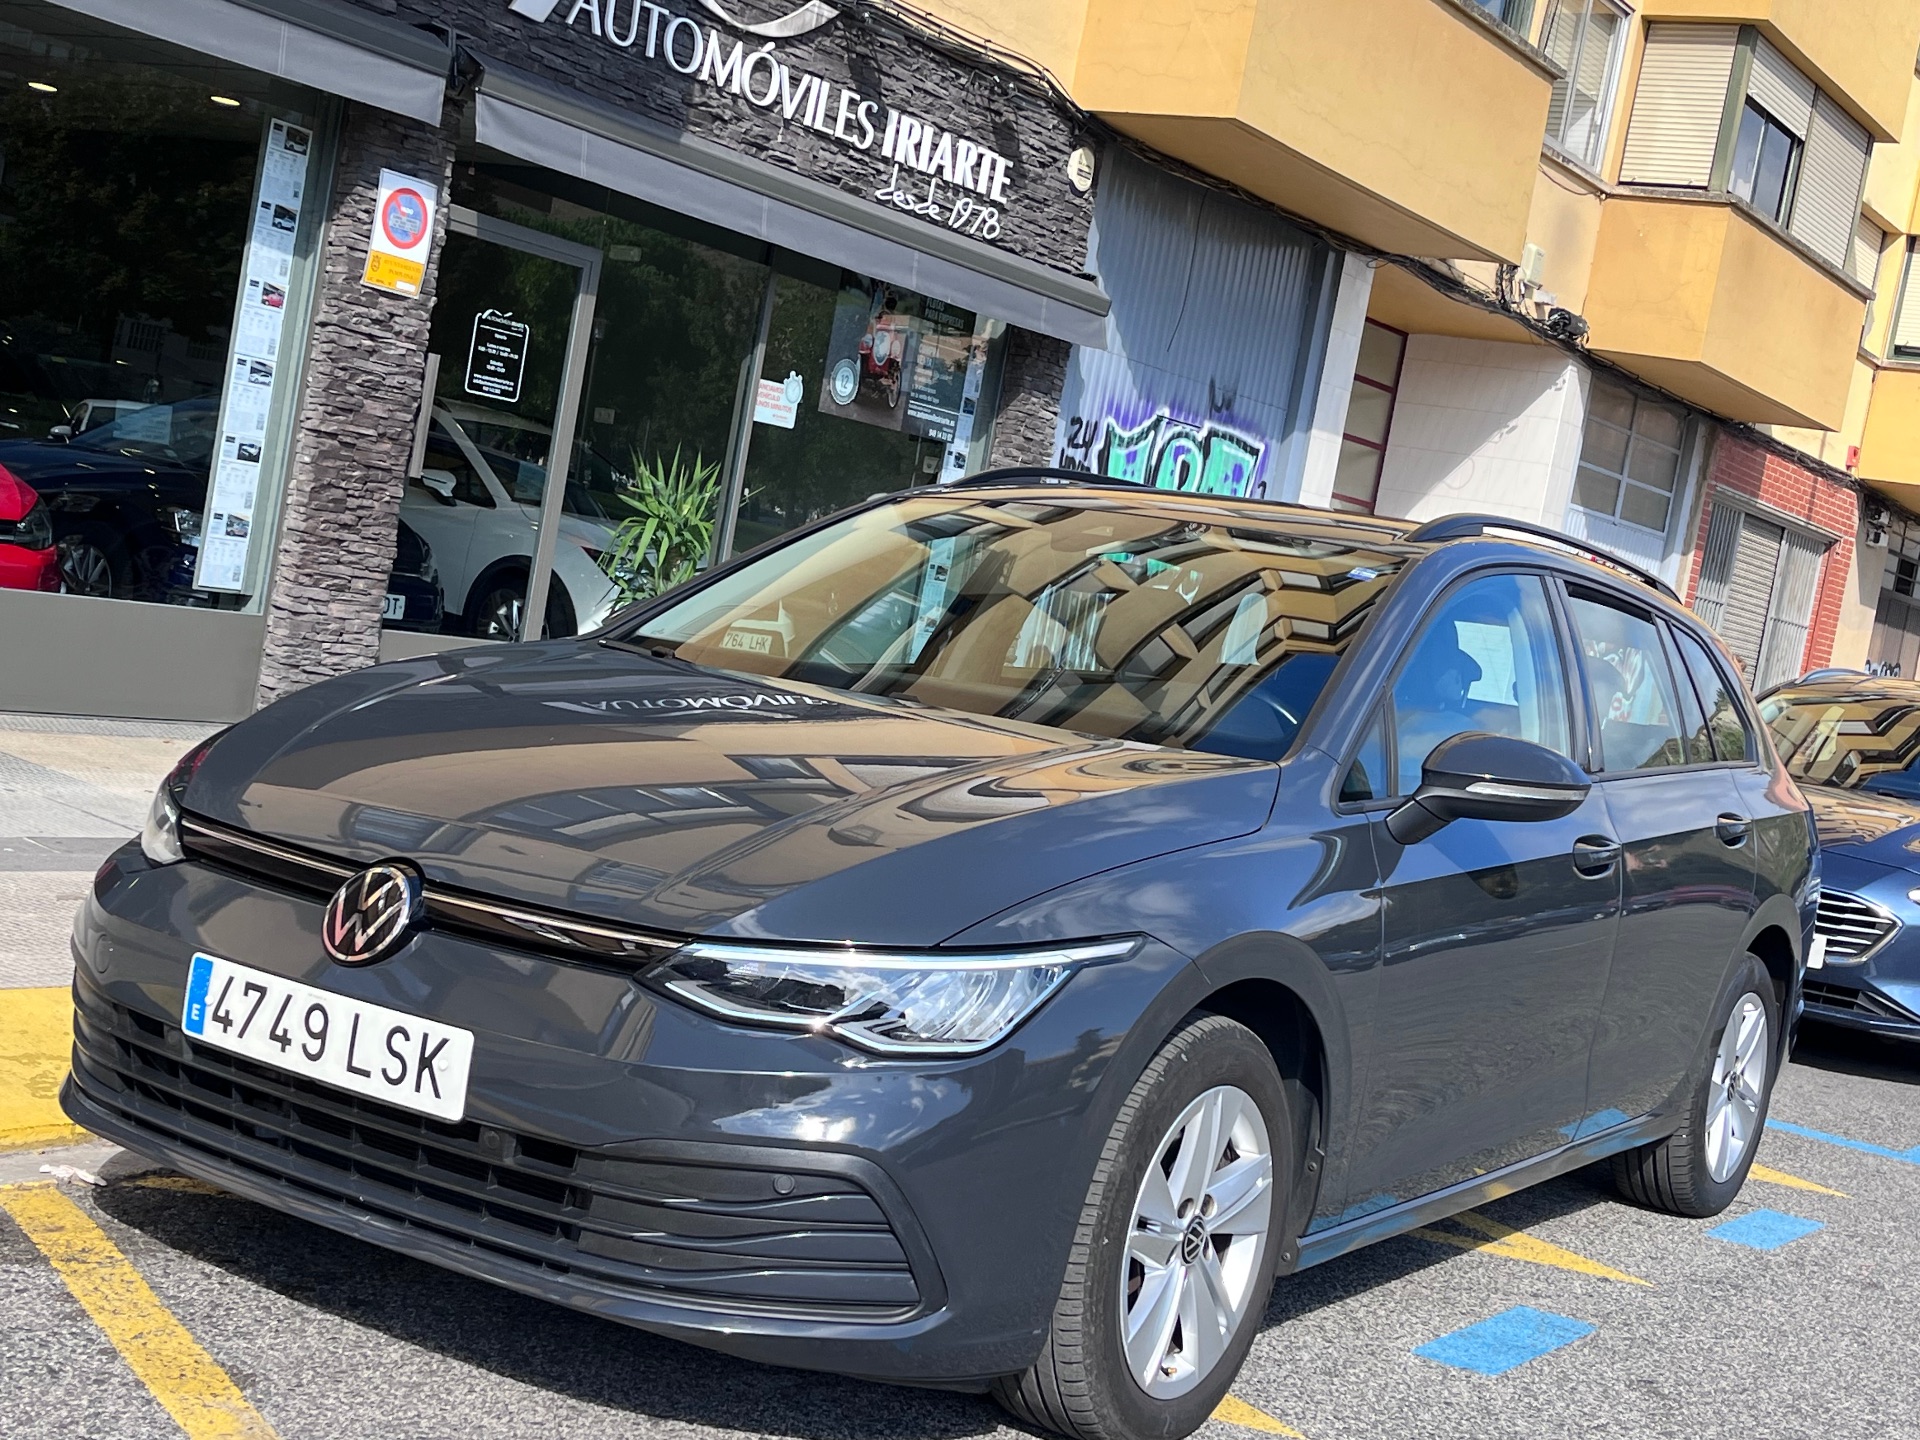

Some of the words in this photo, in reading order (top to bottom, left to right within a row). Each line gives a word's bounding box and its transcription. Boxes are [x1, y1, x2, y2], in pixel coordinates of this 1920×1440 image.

[565, 0, 878, 151] AUTOMÓVILES
[881, 109, 1014, 205] IRIARTE
[874, 163, 942, 223] desde
[948, 198, 1001, 240] 1978
[841, 374, 850, 390] 12
[748, 635, 768, 652] LHK
[190, 1004, 202, 1021] E
[211, 975, 329, 1062] 4749
[346, 1012, 450, 1100] LSK
